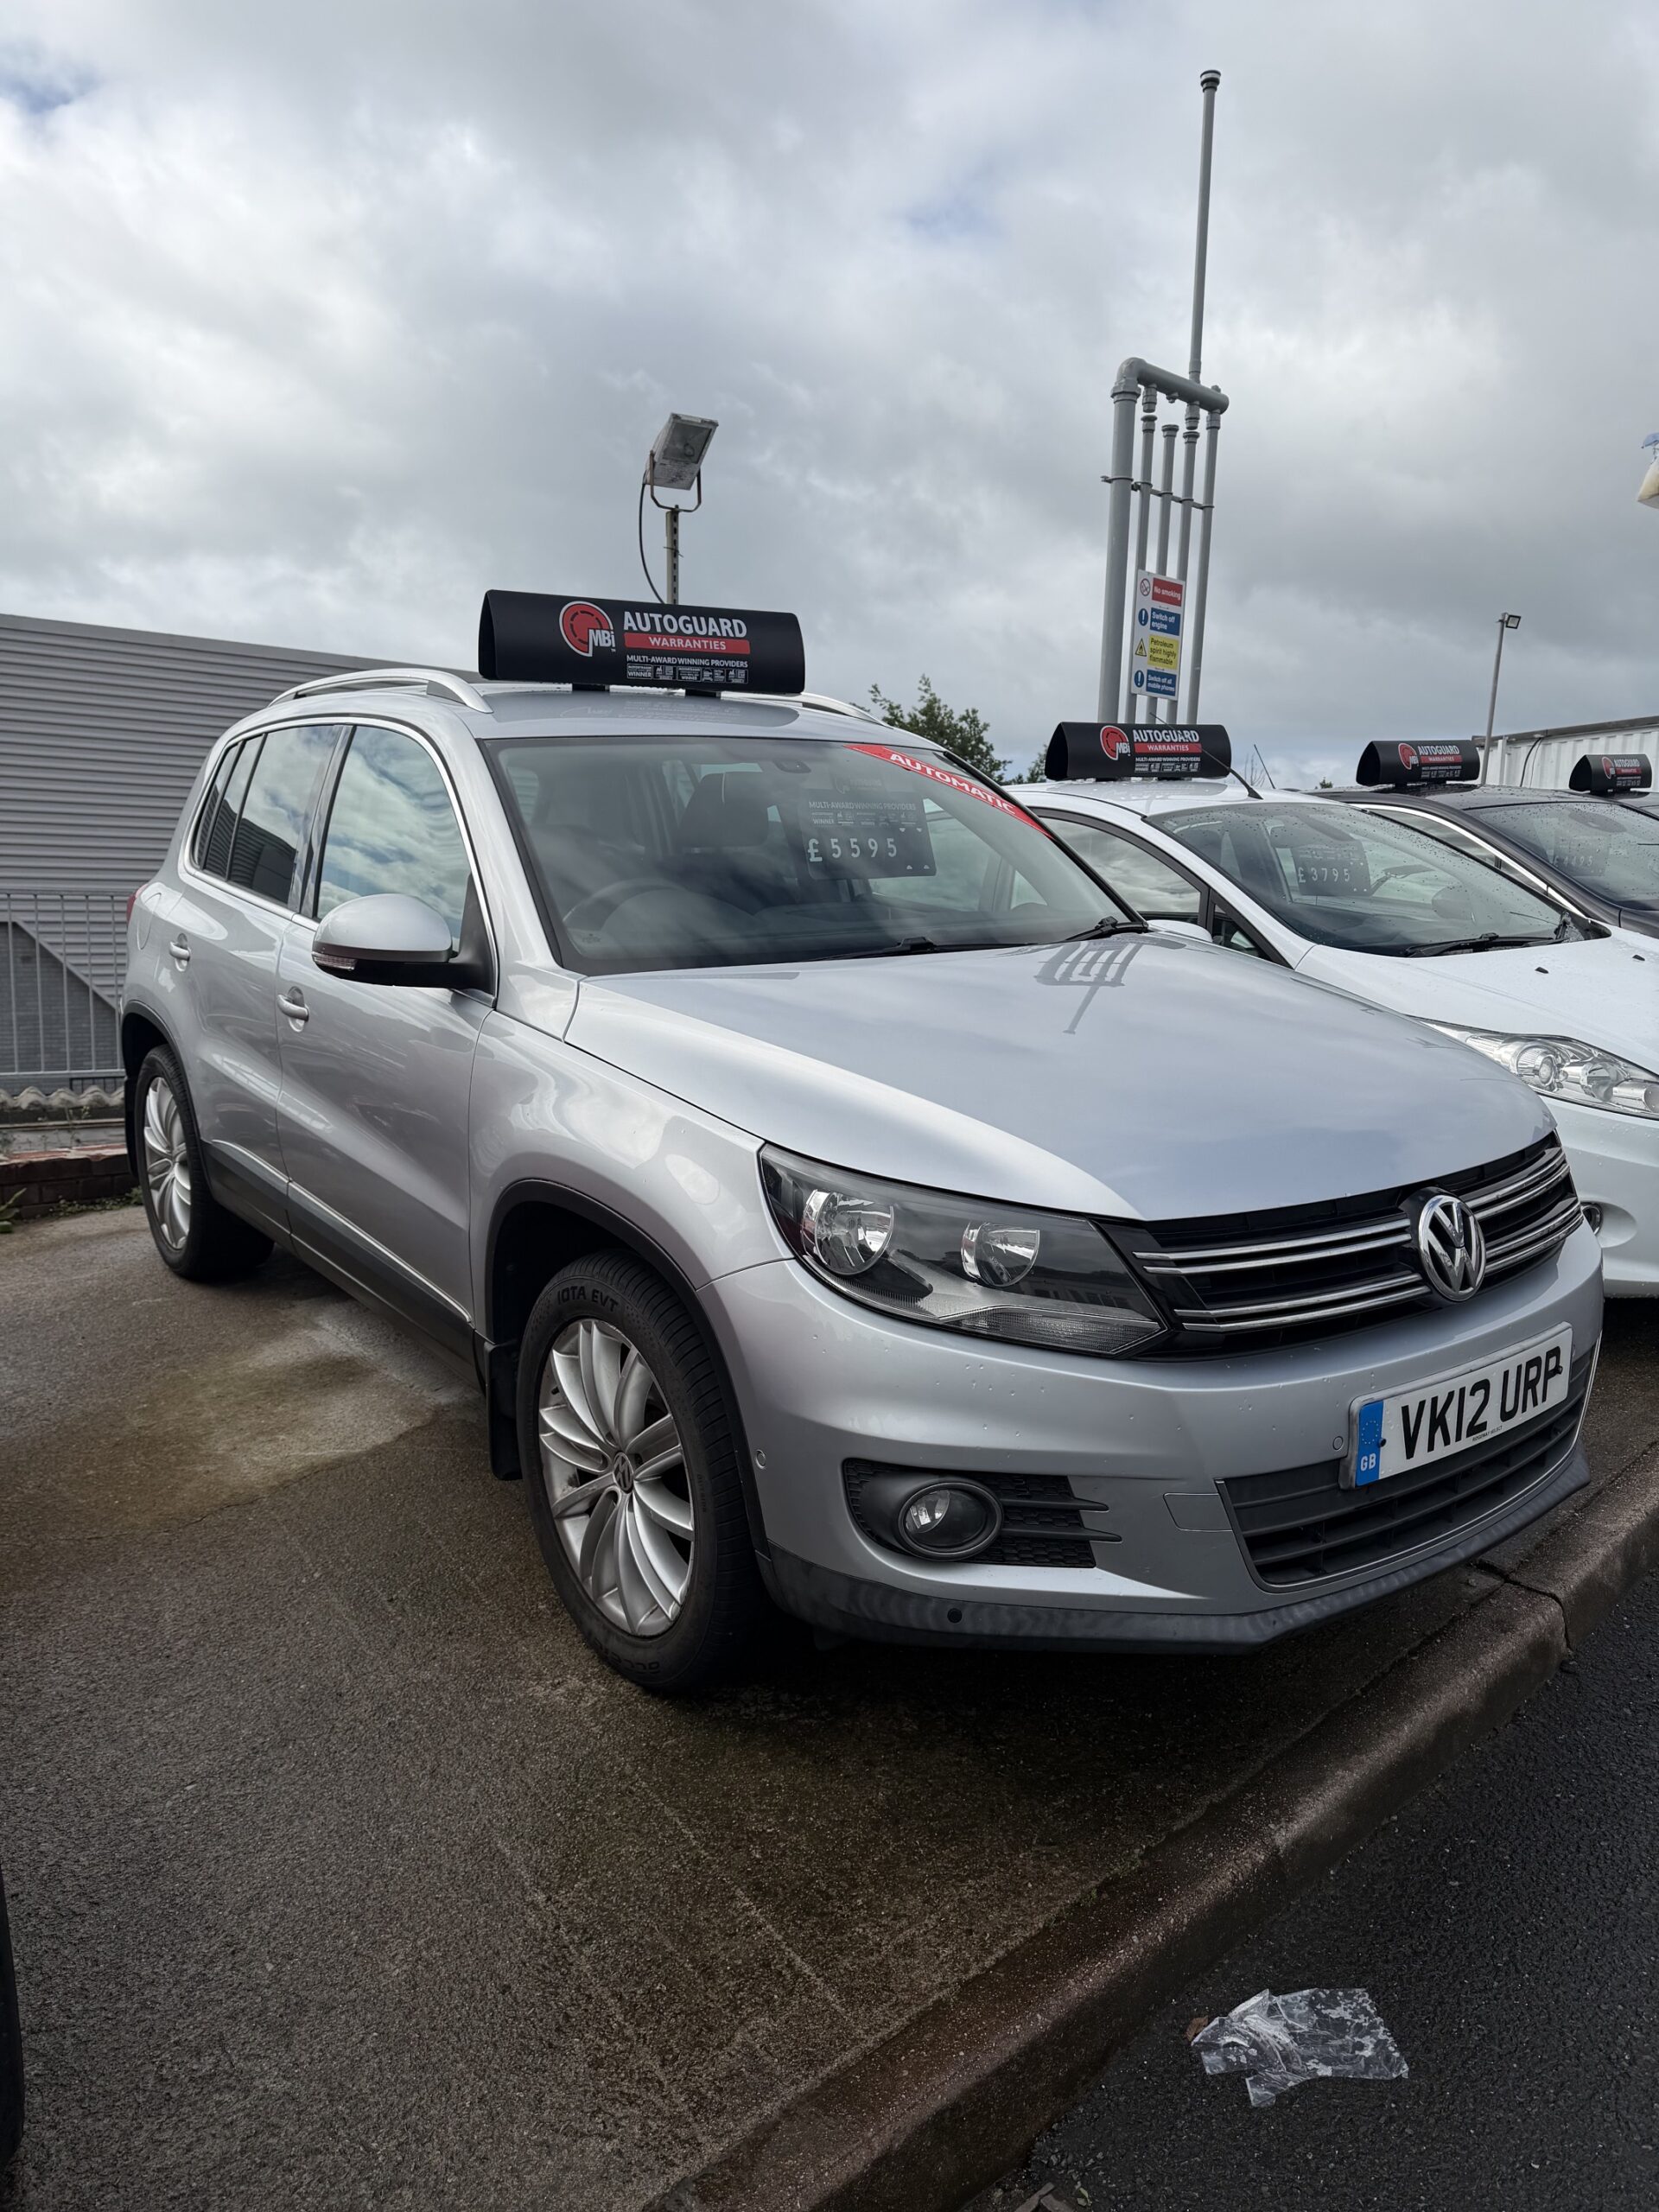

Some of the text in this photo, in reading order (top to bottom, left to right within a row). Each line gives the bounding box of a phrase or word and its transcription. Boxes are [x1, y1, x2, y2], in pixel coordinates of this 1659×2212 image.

[1154, 586, 1182, 601] No smoking
[1152, 611, 1168, 621] Switch
[624, 611, 747, 638] AUTOGUARD
[1151, 621, 1168, 630] engine
[588, 629, 616, 649] MBi
[649, 637, 727, 651] WARRANTIES
[1151, 638, 1174, 649] Petroleum
[1149, 654, 1173, 665] flammable
[1162, 648, 1177, 659] highly
[626, 654, 748, 668] MULTI-AWARD WINNING PROVIDERS
[1133, 729, 1199, 742] AUTOGUARD
[1418, 745, 1460, 755] AUTOGUARD
[889, 753, 1018, 816] AUTOMATIC
[884, 802, 917, 811] PROVIDERS
[556, 1285, 588, 1306] IOTA
[1401, 1345, 1563, 1460] VK12 URP
[1359, 1452, 1376, 1471] GB
